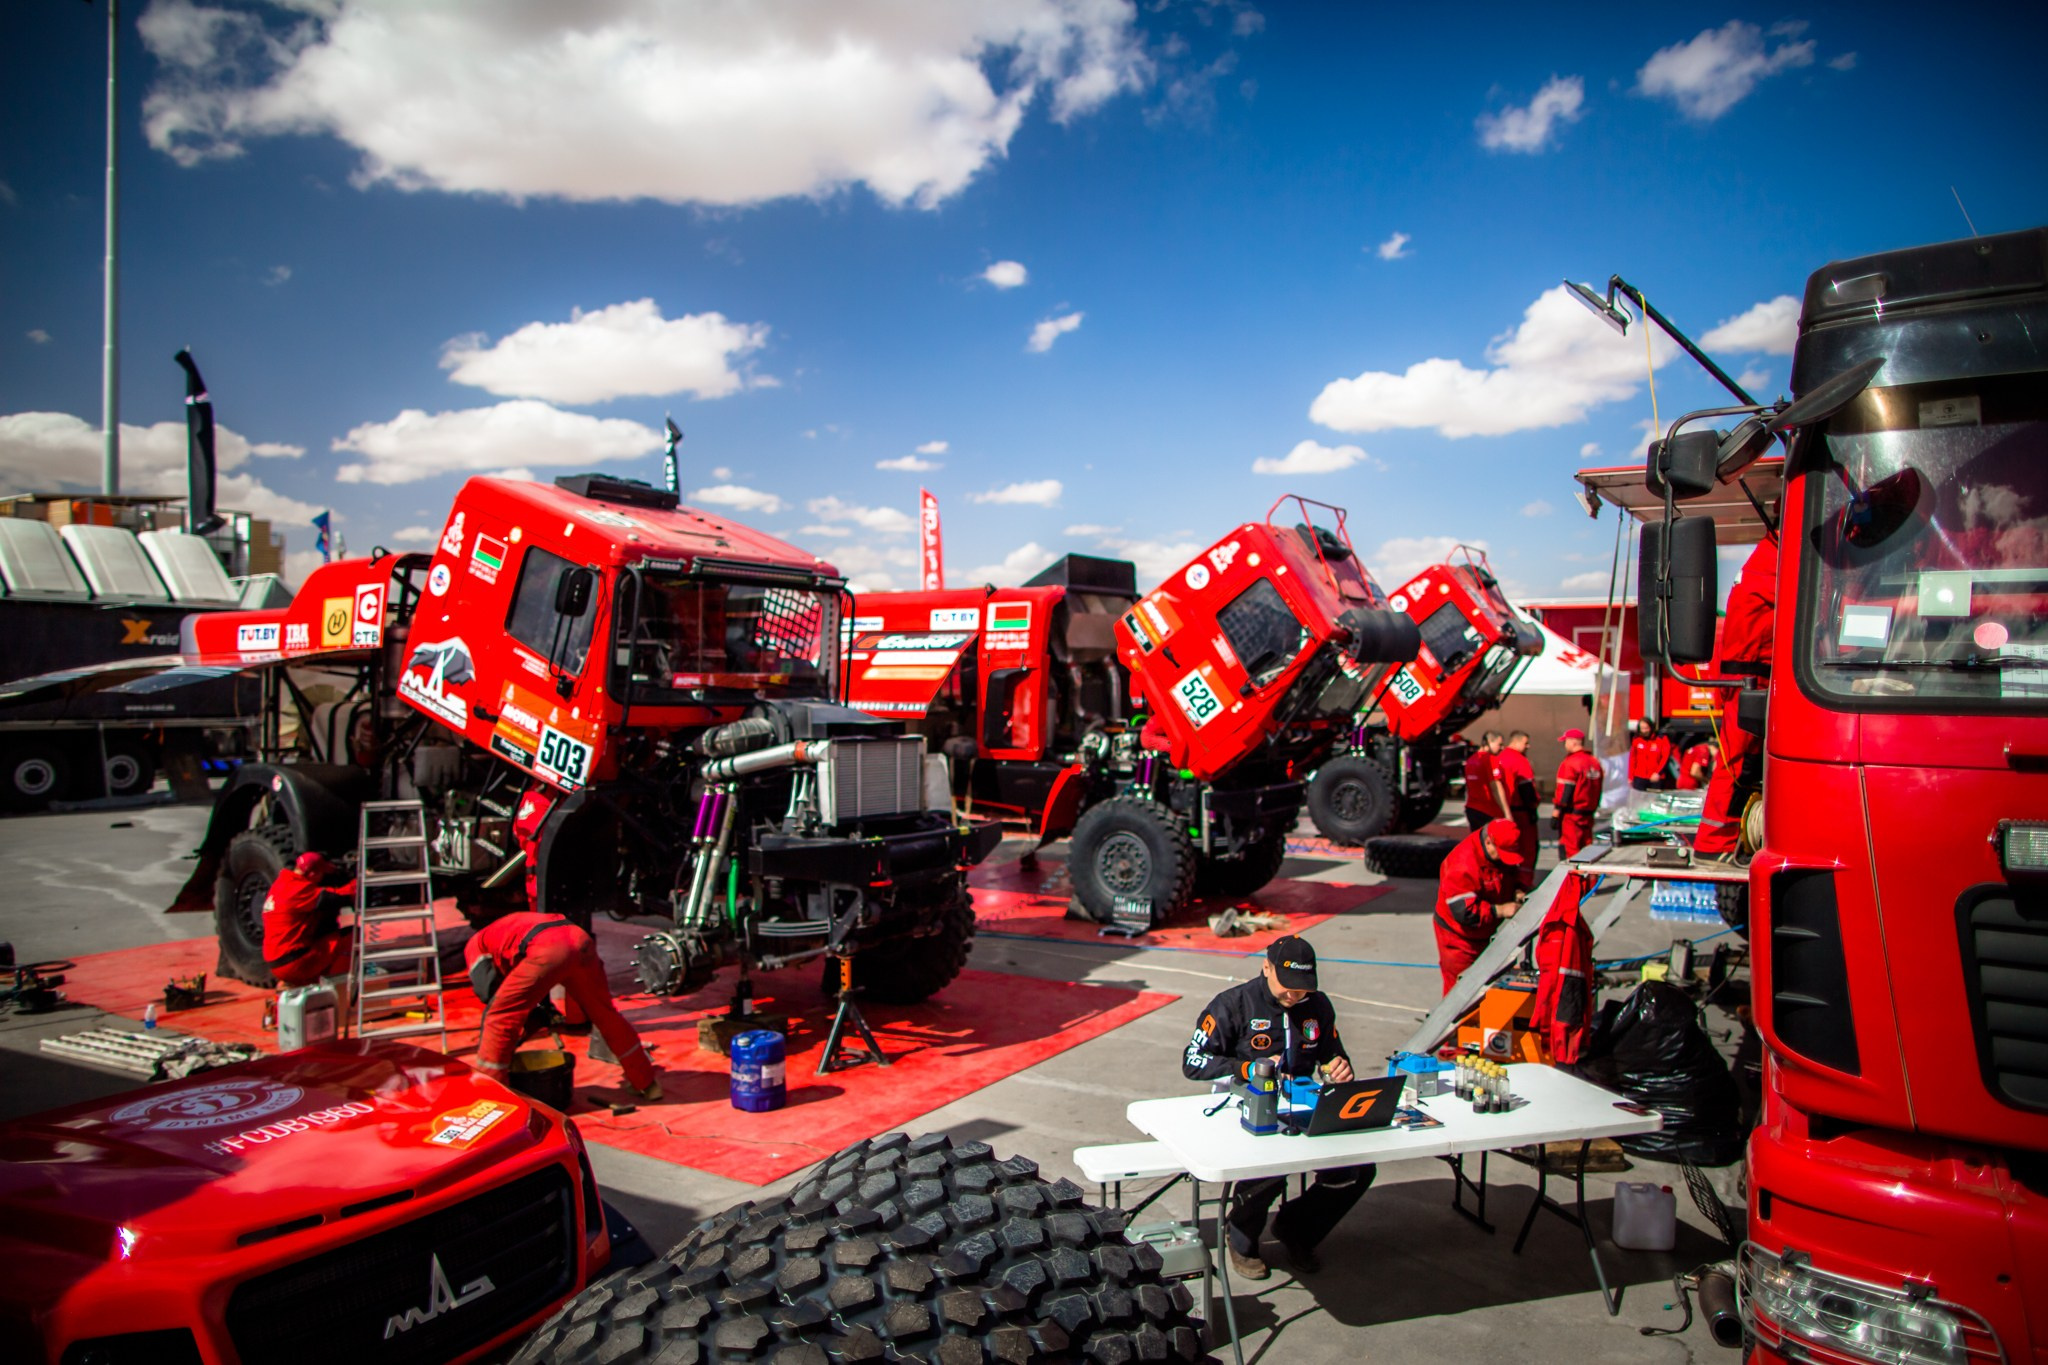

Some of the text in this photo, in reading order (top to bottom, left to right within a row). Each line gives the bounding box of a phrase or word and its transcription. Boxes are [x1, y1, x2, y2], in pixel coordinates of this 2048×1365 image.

[240, 627, 278, 642] TUT.BY
[1181, 676, 1218, 719] 528
[540, 729, 587, 781] 503
[165, 1110, 259, 1129] DYNAMO
[1338, 1089, 1383, 1120] G
[203, 1101, 375, 1156] #FCDB1960
